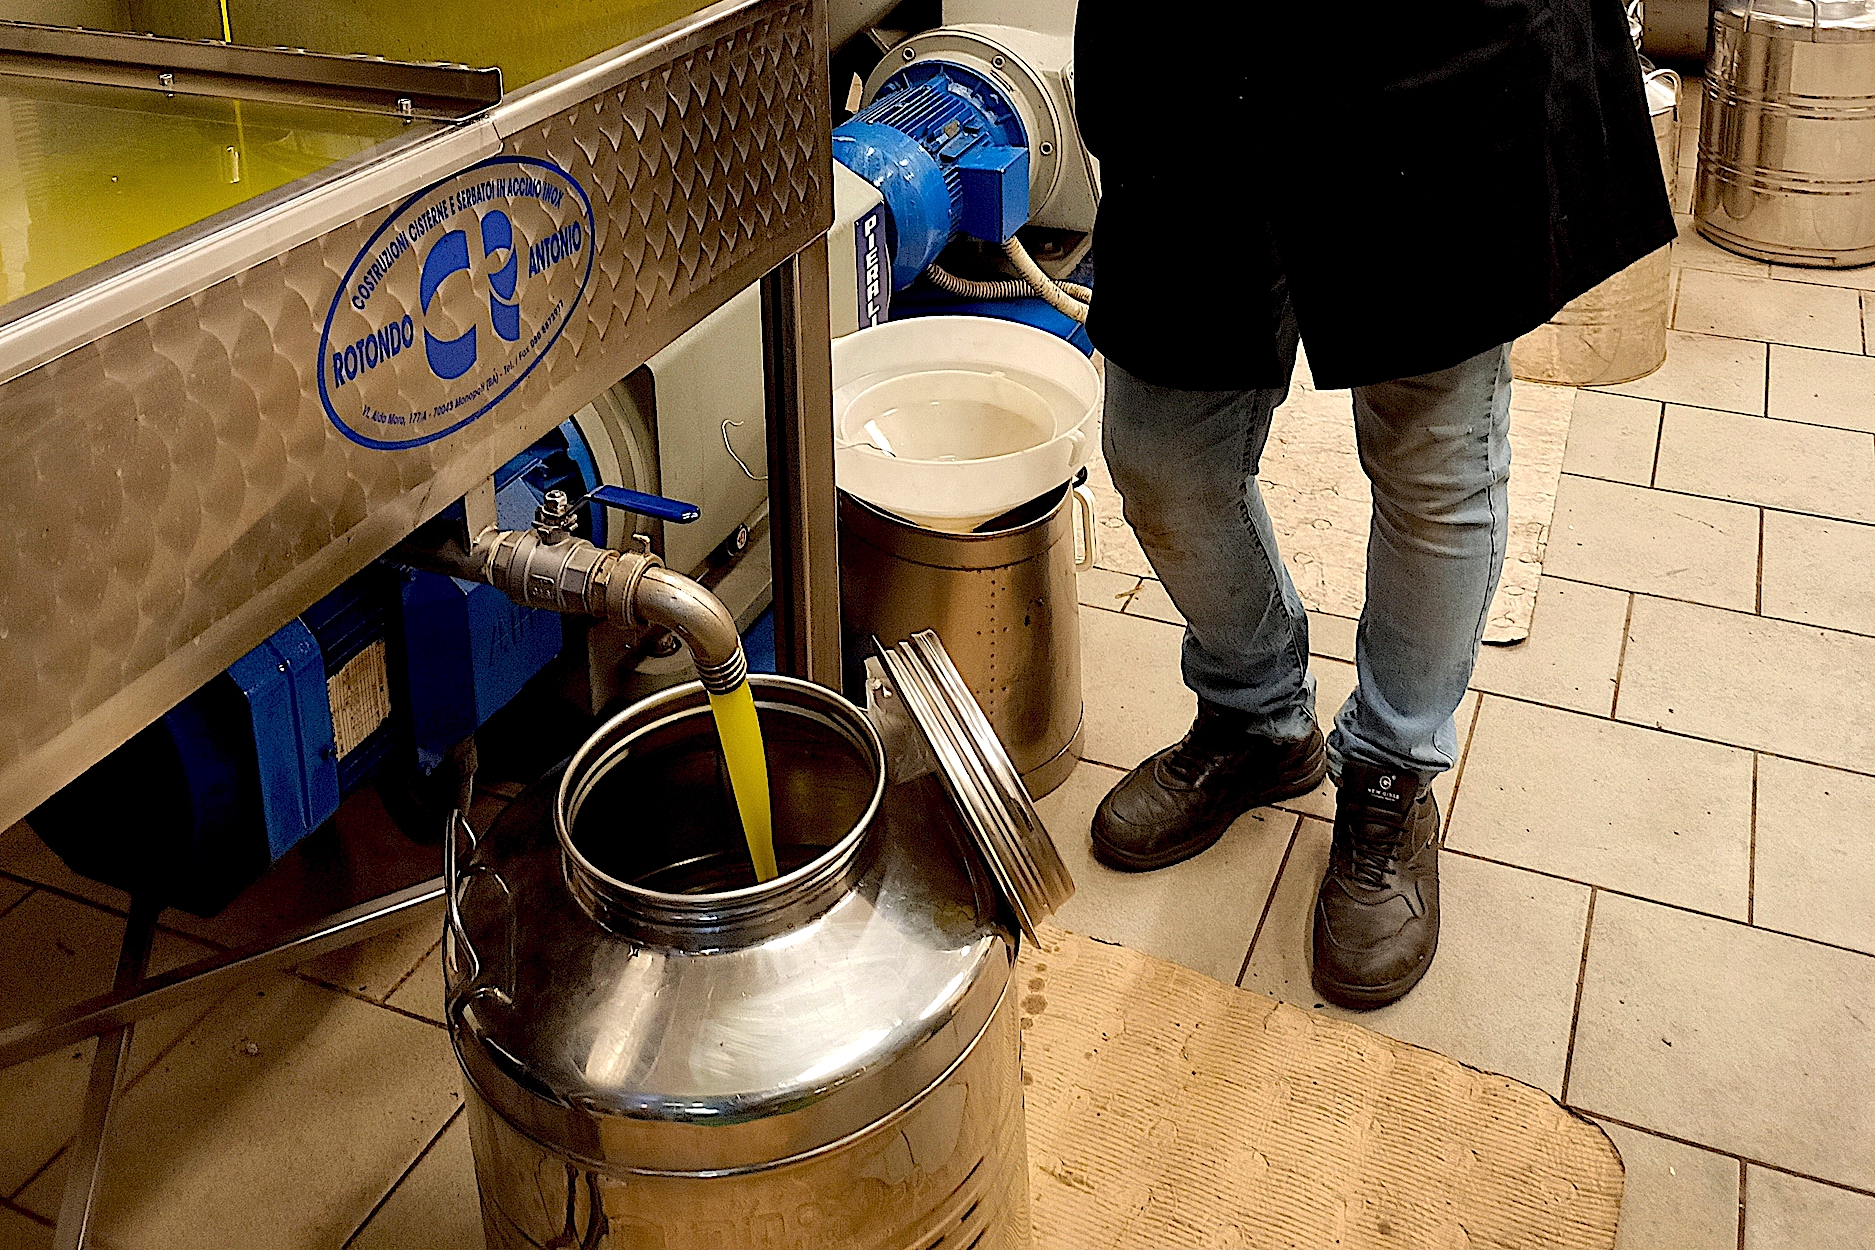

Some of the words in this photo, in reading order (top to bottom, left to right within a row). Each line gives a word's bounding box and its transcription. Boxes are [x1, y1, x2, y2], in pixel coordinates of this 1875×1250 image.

[351, 230, 410, 310] COSTRUZIONI
[407, 199, 450, 243] CISTERNE
[448, 194, 457, 216] E
[455, 180, 496, 212] SERBATOI
[506, 177, 542, 199] ACCIAIO
[541, 180, 565, 210] INOX
[528, 220, 582, 279] ANTONIO
[332, 314, 414, 389] ROTONDO
